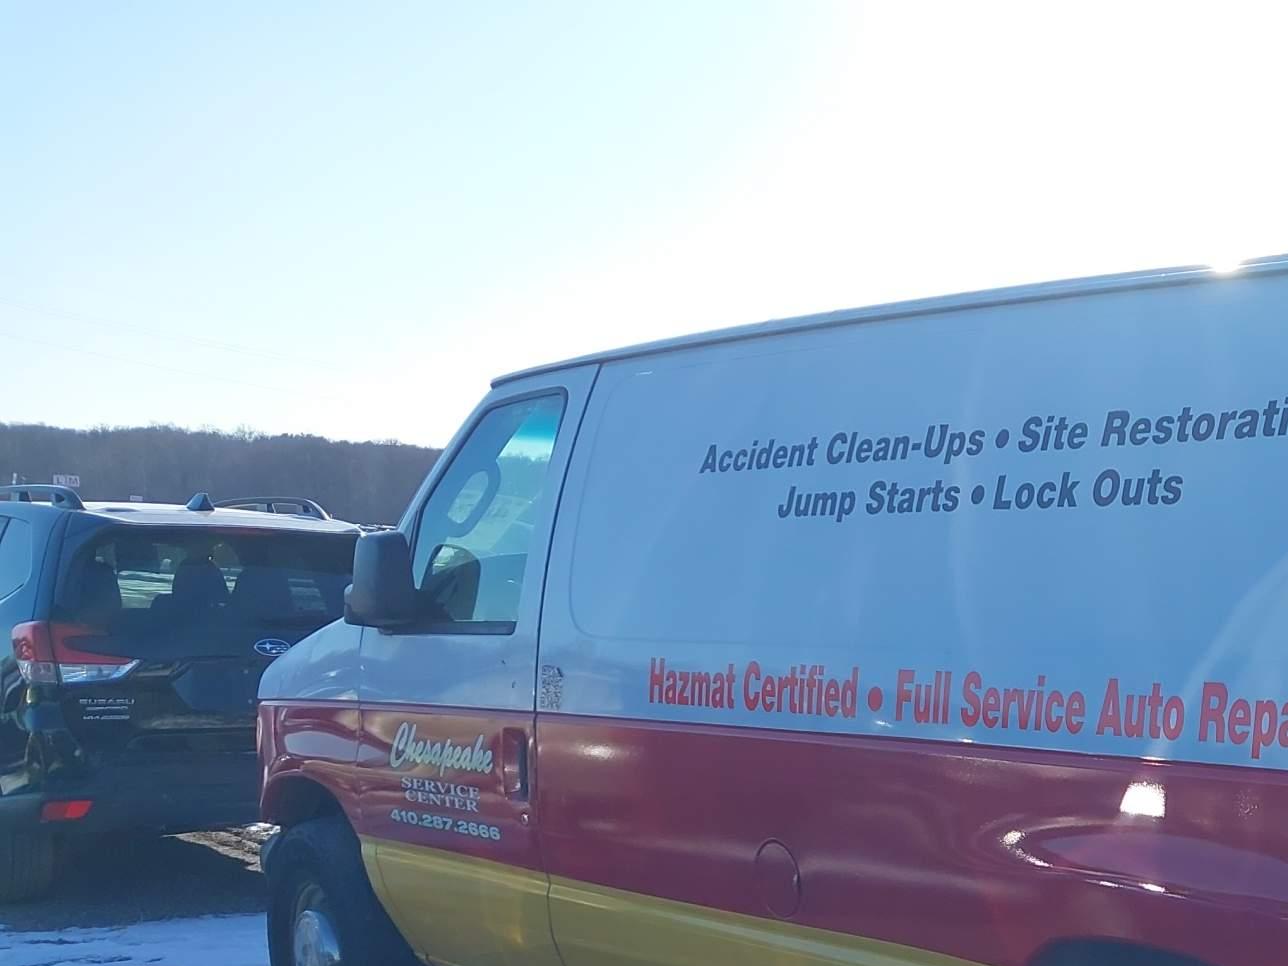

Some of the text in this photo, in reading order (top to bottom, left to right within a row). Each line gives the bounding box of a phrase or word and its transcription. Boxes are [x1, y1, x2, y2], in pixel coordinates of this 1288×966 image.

[699, 434, 818, 474] Accident
[825, 424, 986, 465] Clean-Ups
[1017, 416, 1089, 453] Site
[777, 468, 1184, 523] Jump Starts Lock Outs
[649, 656, 736, 710] Hazmat
[743, 661, 860, 719] Certified
[894, 669, 951, 725] Full
[960, 671, 1085, 735] Service
[1096, 678, 1185, 743] Auto
[389, 722, 494, 778] Chesapeake
[401, 776, 481, 801] SERVICE
[405, 789, 479, 813] CENTER
[390, 808, 501, 841] 410.287.2666
